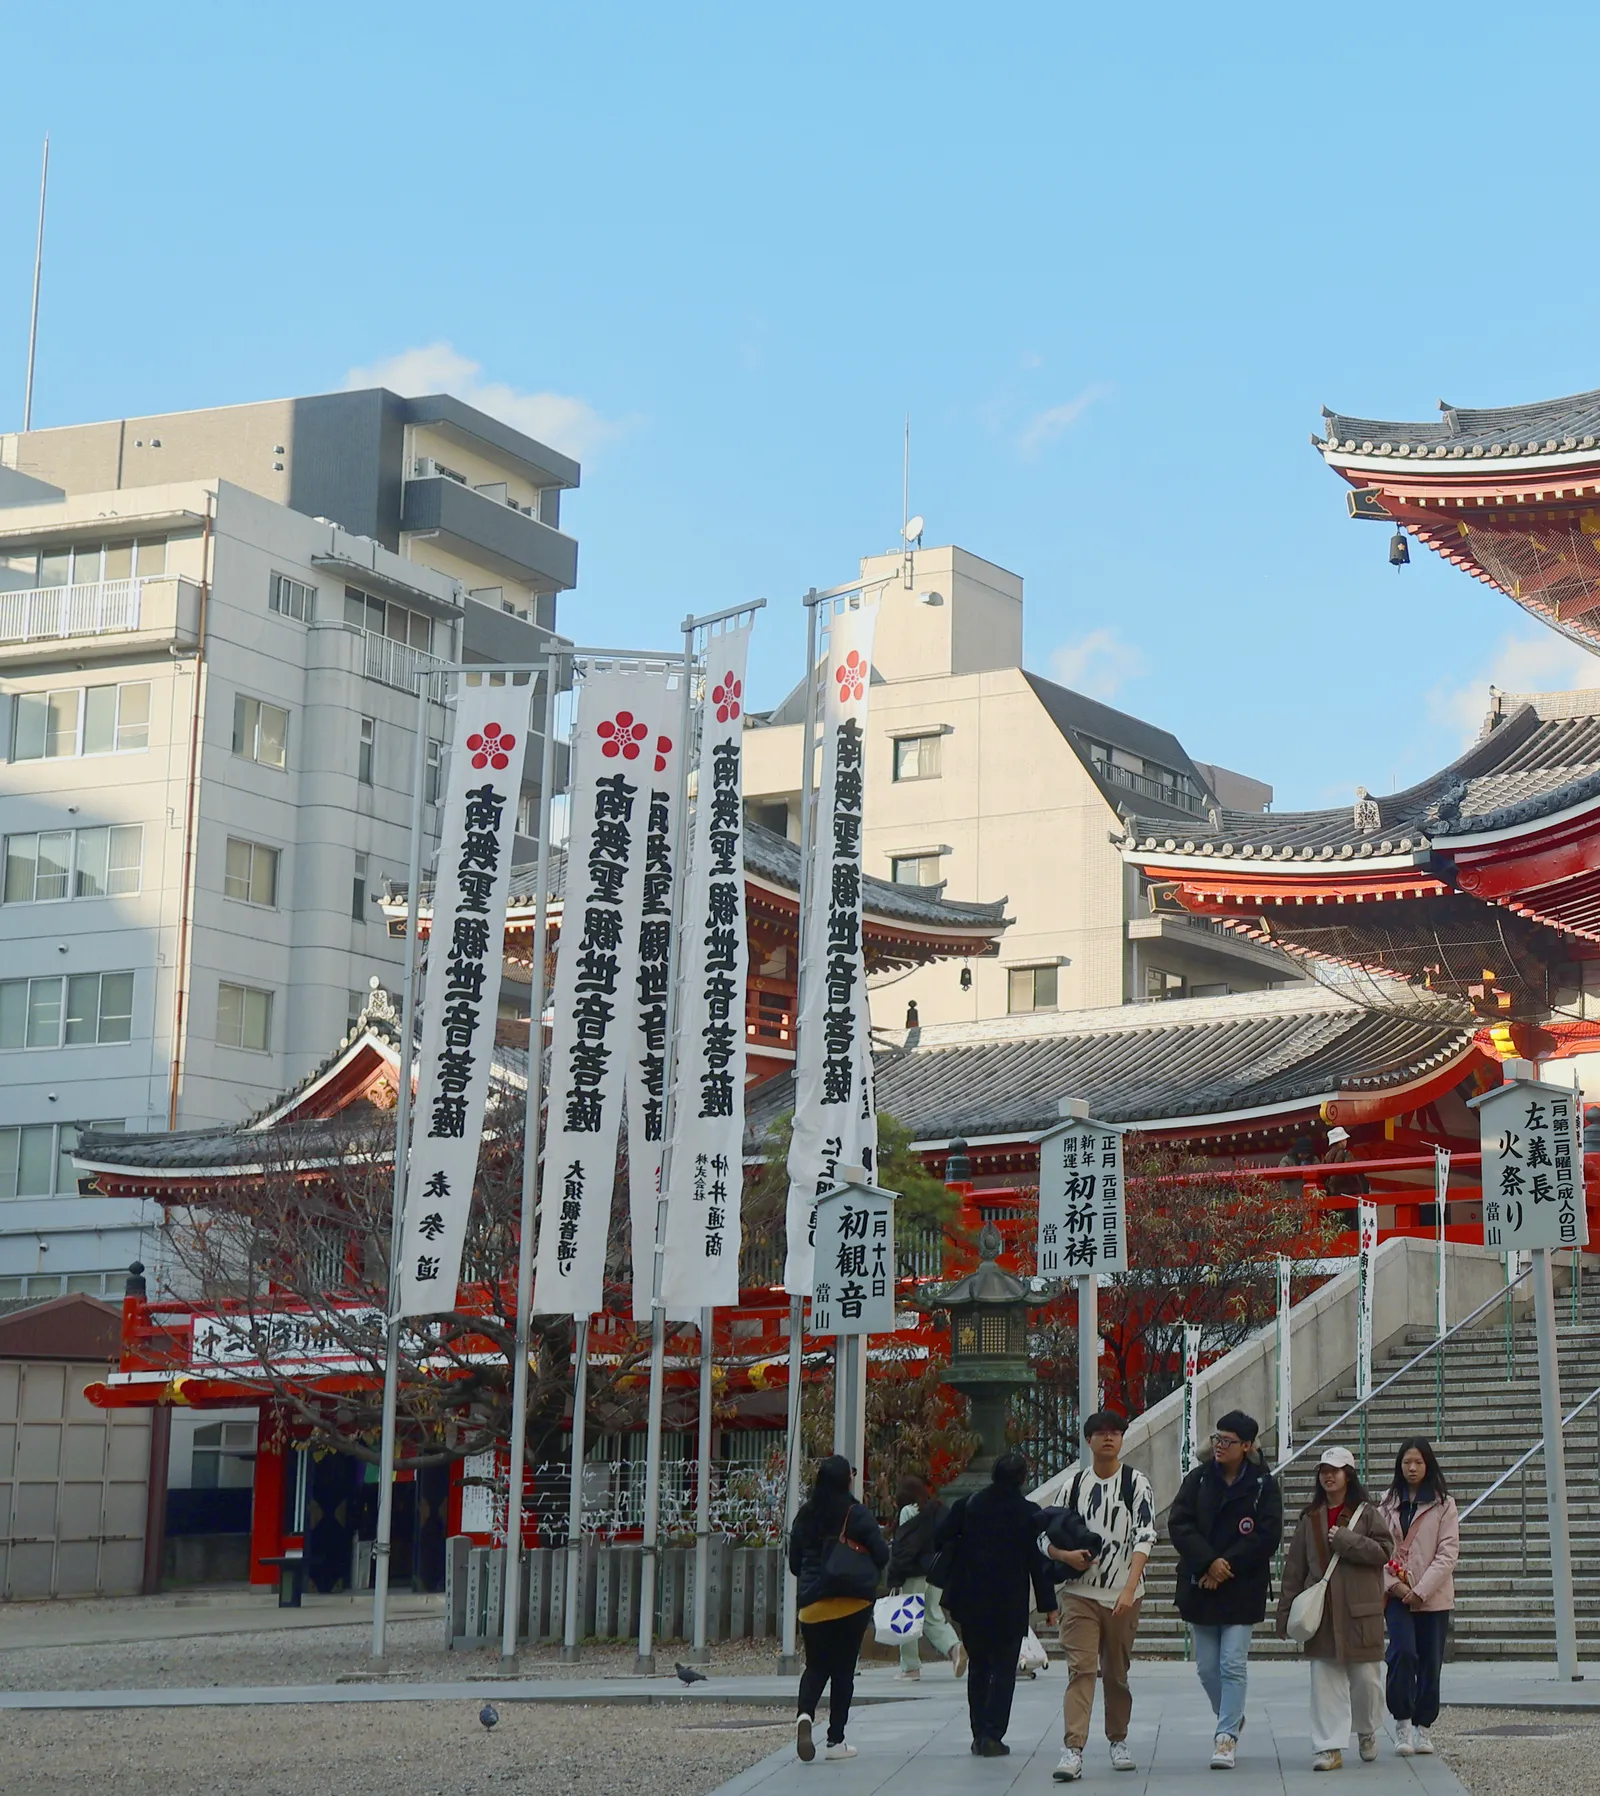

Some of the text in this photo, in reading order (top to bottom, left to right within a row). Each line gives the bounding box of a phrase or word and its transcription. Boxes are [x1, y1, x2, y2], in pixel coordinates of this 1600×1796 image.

[1062, 1137, 1078, 1168] 開運
[1080, 1134, 1096, 1168] 新年
[1499, 1129, 1526, 1233] 火祭り
[1524, 1101, 1557, 1205] 左義長
[1042, 1223, 1058, 1271] 當山
[1063, 1171, 1098, 1268] 初祈祷
[1486, 1201, 1502, 1246] 當山
[835, 1205, 869, 1319] 初観音
[872, 1210, 888, 1297] 一月十八日
[815, 1282, 831, 1330] 當山
